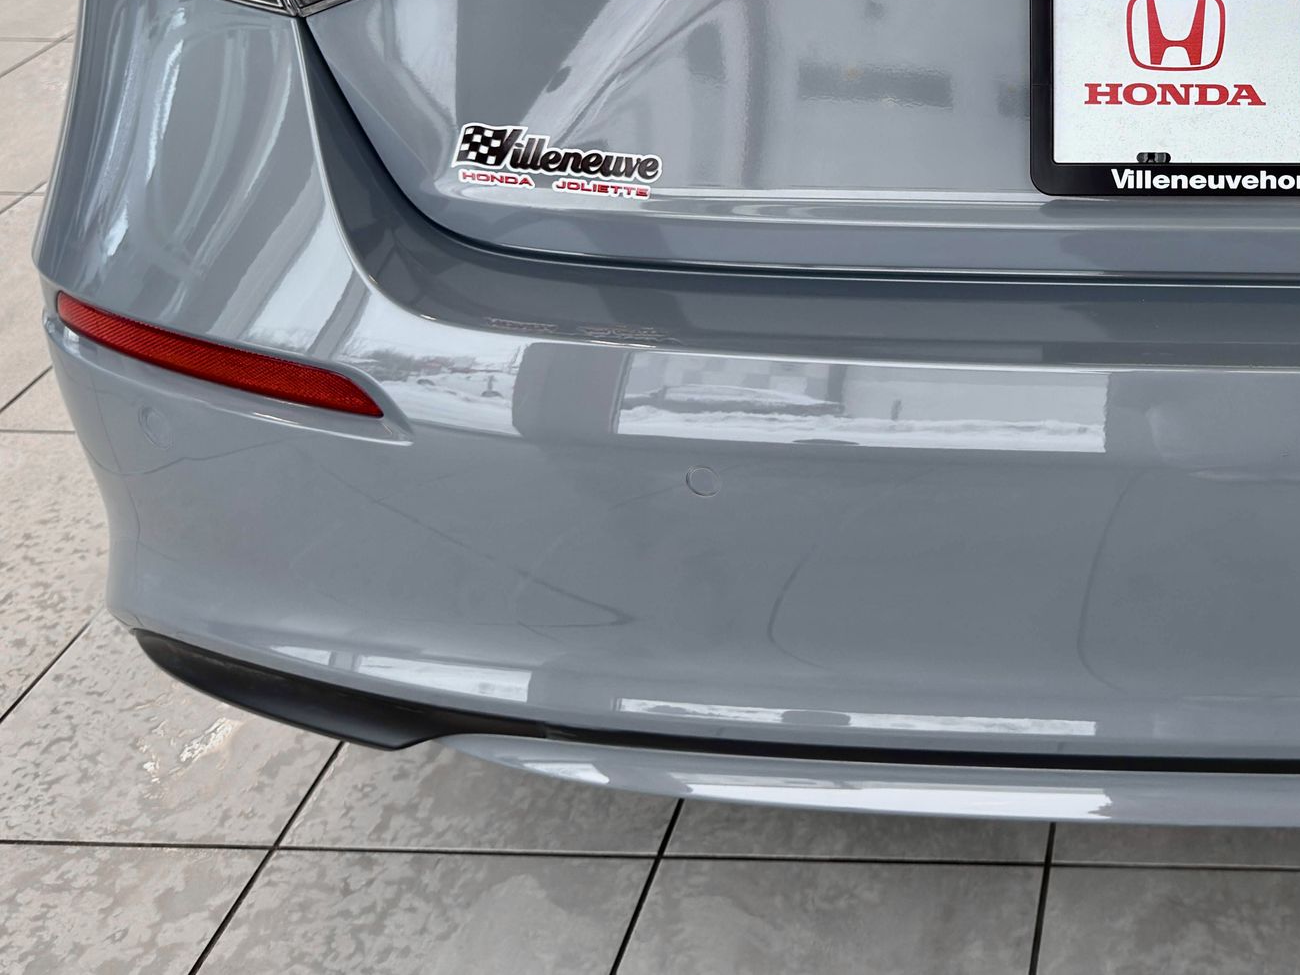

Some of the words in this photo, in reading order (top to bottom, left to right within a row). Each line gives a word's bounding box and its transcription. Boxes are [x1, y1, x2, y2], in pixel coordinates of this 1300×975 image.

[1084, 83, 1266, 106] HONDA
[499, 128, 659, 179] Villeneuve
[462, 171, 533, 187] HONDA
[555, 180, 649, 197] JOLIETTE
